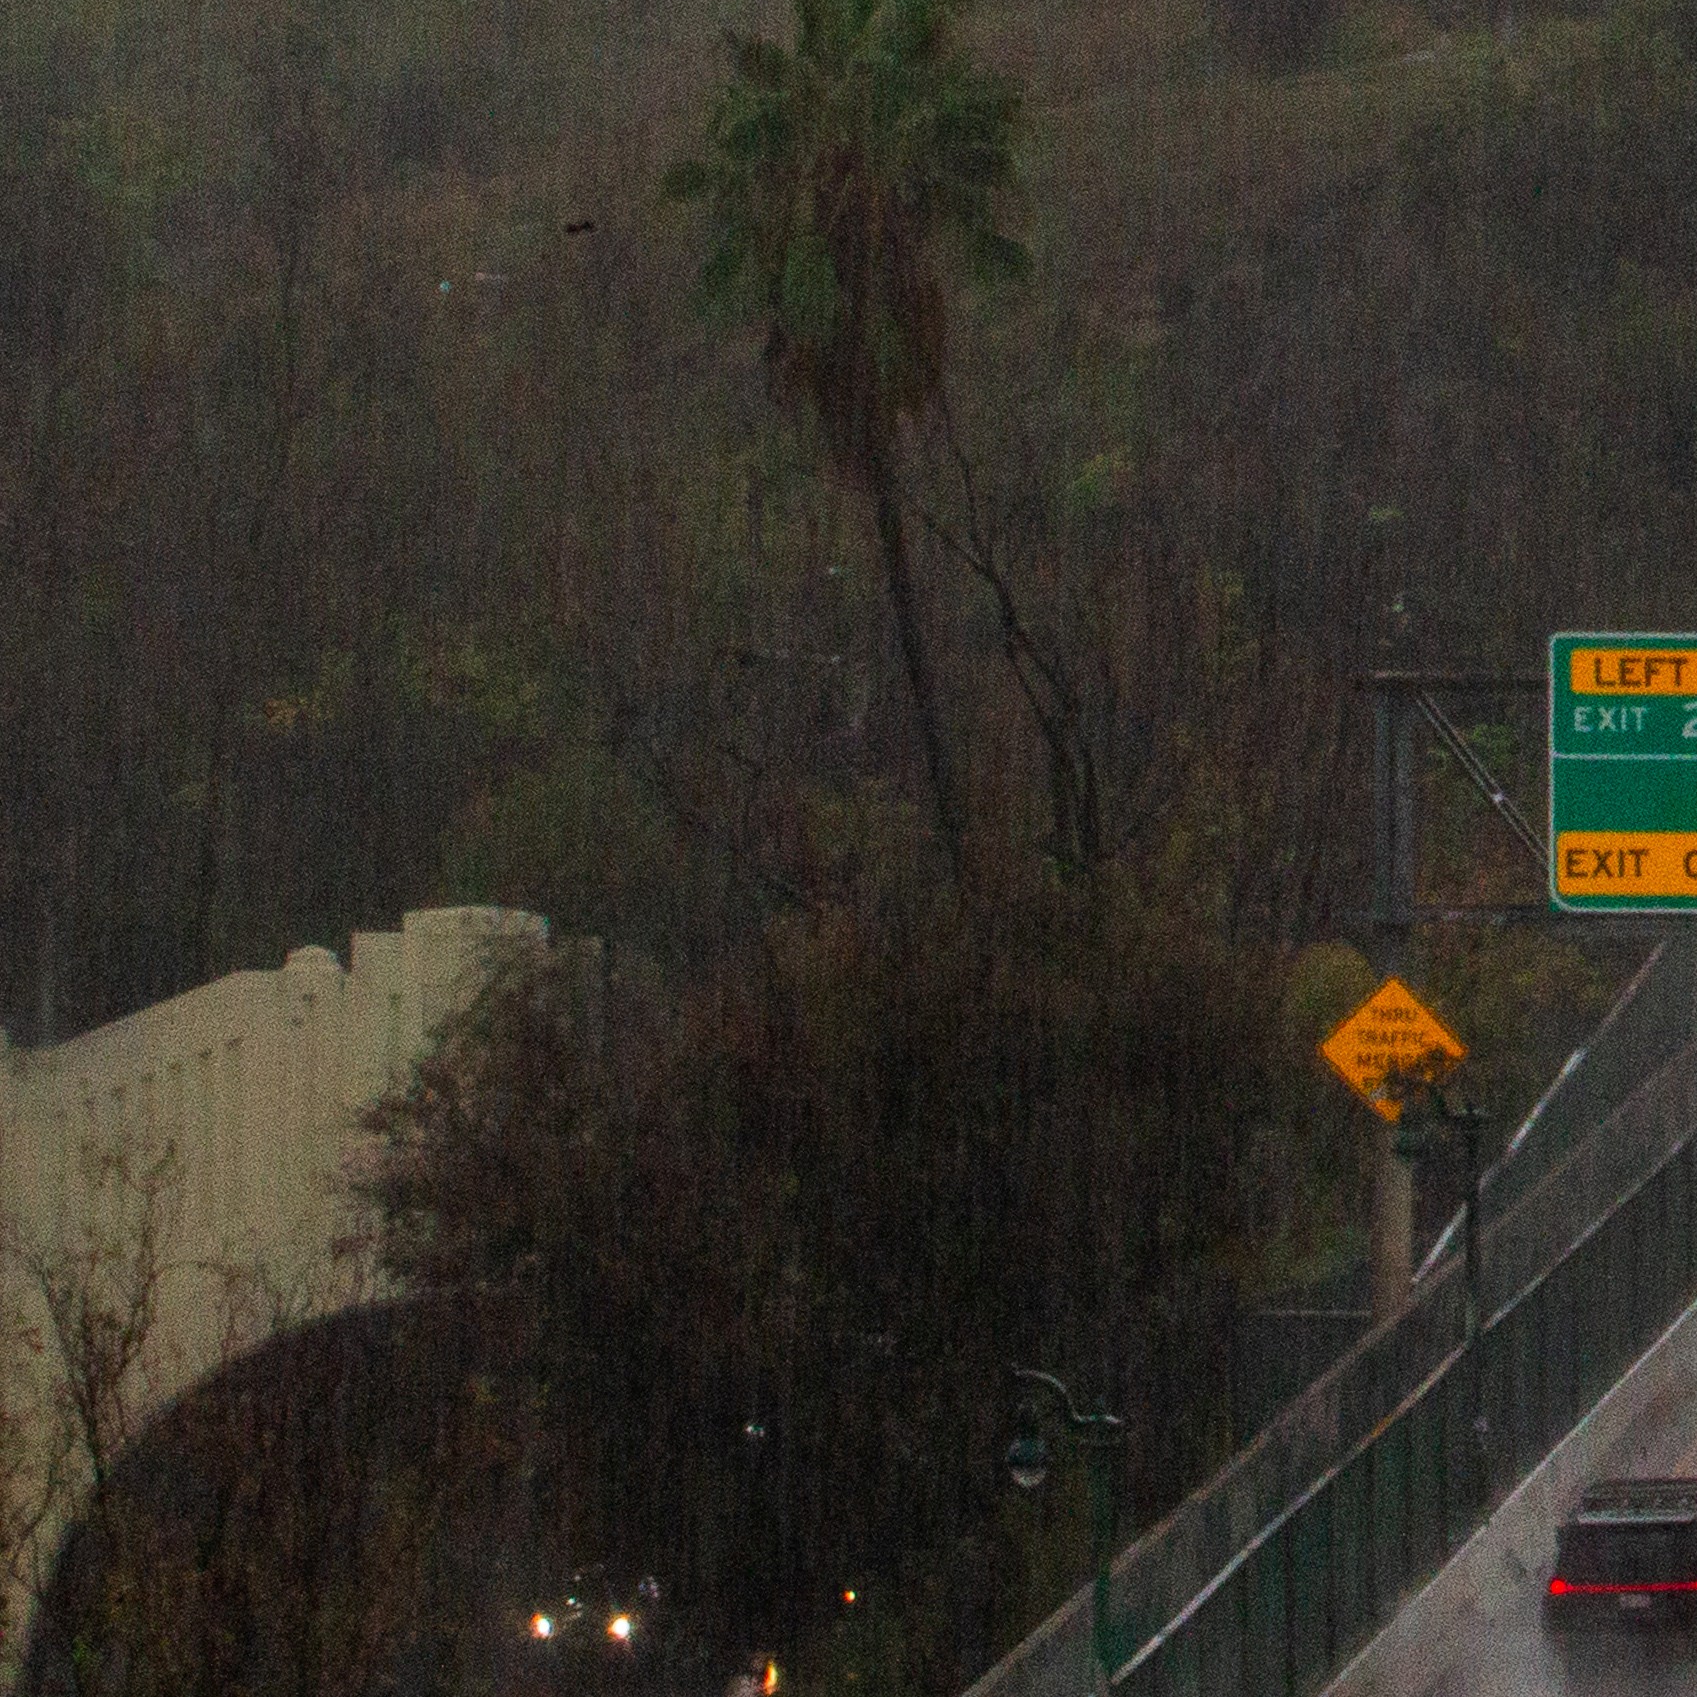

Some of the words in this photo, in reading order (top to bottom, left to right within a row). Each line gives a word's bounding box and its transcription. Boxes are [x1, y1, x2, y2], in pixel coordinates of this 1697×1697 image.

[1595, 655, 1690, 688] LEFT
[1573, 705, 1646, 733] EXIT
[1565, 847, 1648, 879] EXIT
[1371, 1007, 1418, 1023] THRU
